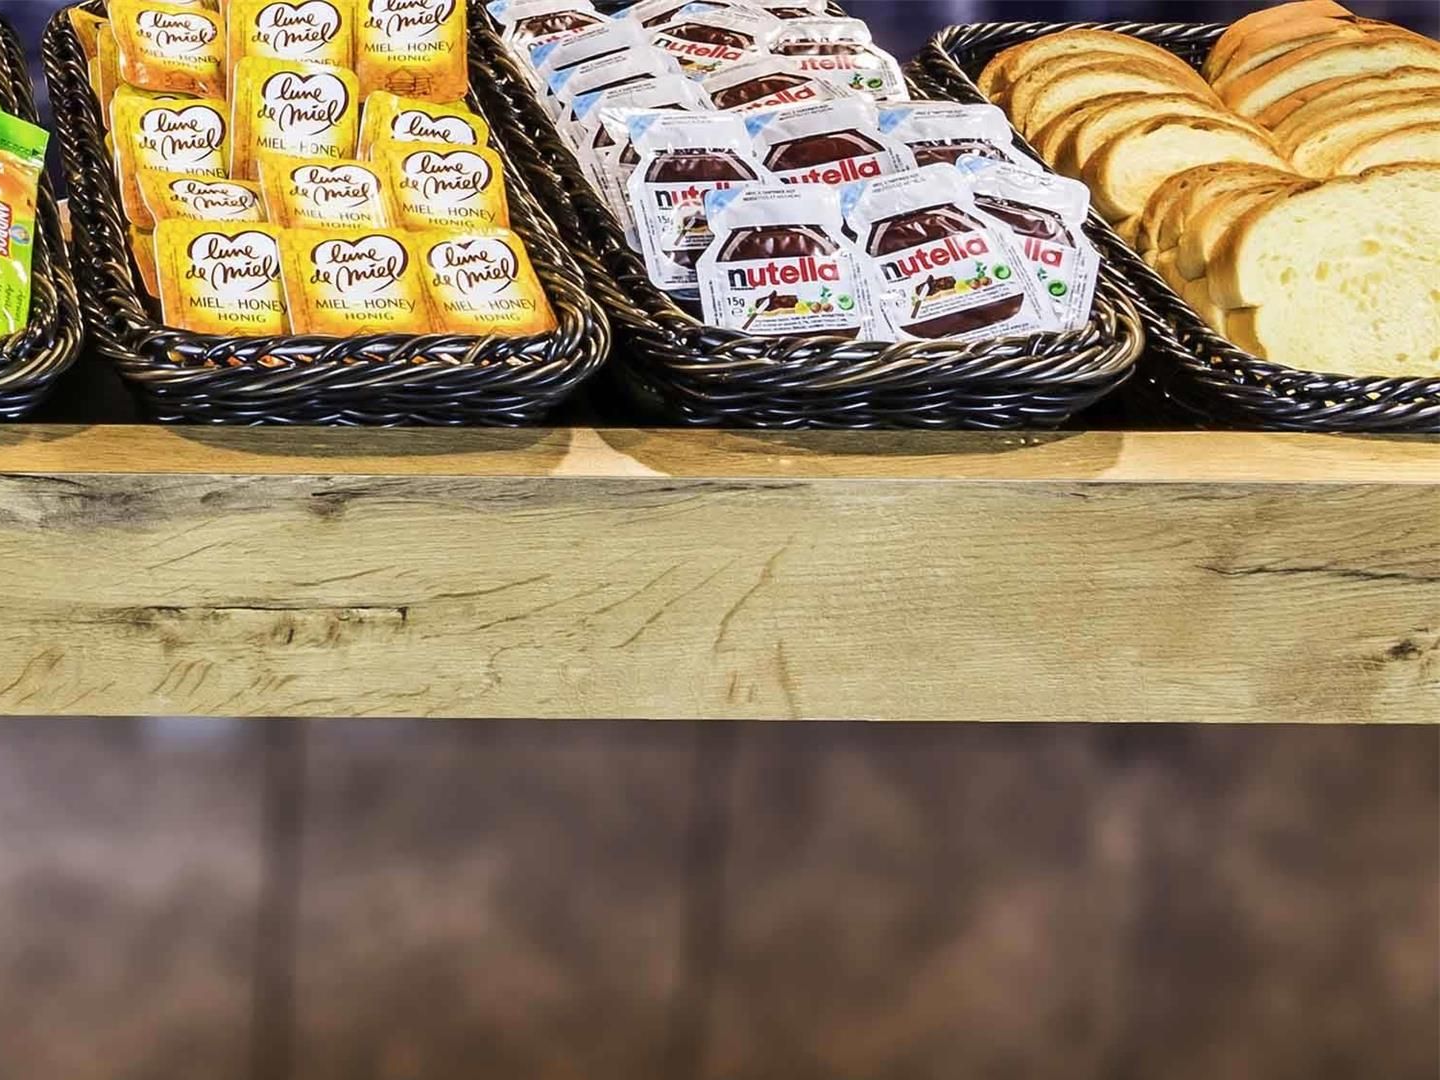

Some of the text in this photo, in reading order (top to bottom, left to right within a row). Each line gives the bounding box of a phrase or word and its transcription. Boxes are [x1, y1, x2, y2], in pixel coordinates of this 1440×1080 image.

[654, 36, 743, 62] nutella
[274, 77, 328, 104] lune
[257, 99, 341, 131] de miel
[256, 137, 287, 150] MIEL
[413, 156, 470, 175] lune
[400, 171, 487, 201] de miel
[402, 203, 497, 223] MIEL HONEY
[202, 237, 260, 261] lune
[326, 243, 385, 264] lune
[441, 247, 497, 268] lune
[880, 236, 989, 281] nutella
[185, 257, 280, 292] de miel
[310, 255, 402, 293] de miel
[432, 257, 519, 295] de miel
[727, 257, 841, 288] nutella
[190, 297, 288, 315] MIEL HONEY
[315, 299, 416, 313] MIEL HONEY
[444, 299, 537, 313] MIEL HONEY
[726, 294, 745, 308] 15g
[218, 312, 267, 323] HONIG
[345, 312, 395, 321] HONIG
